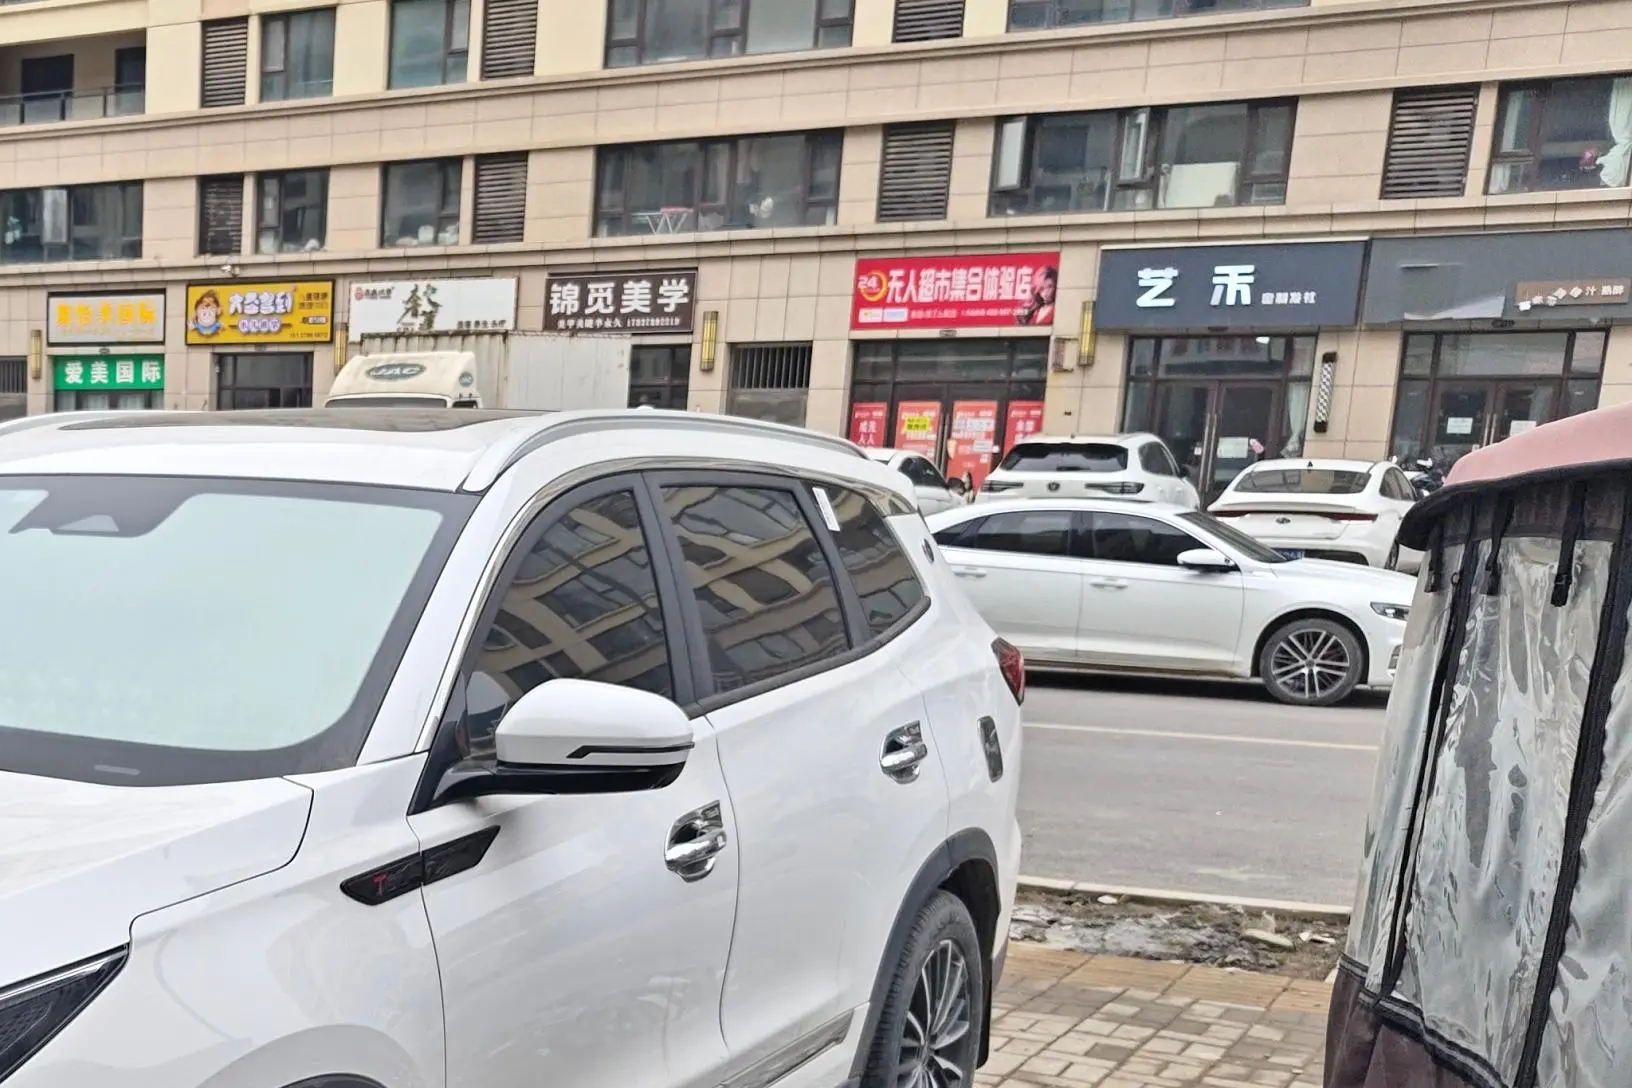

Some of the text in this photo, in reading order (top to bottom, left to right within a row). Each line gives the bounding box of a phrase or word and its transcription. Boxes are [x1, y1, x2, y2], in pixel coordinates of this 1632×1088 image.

[549, 278, 689, 315] 锦觅美学
[886, 266, 1033, 304] 无人超市集合体验店
[64, 360, 161, 384] 爱美国际
